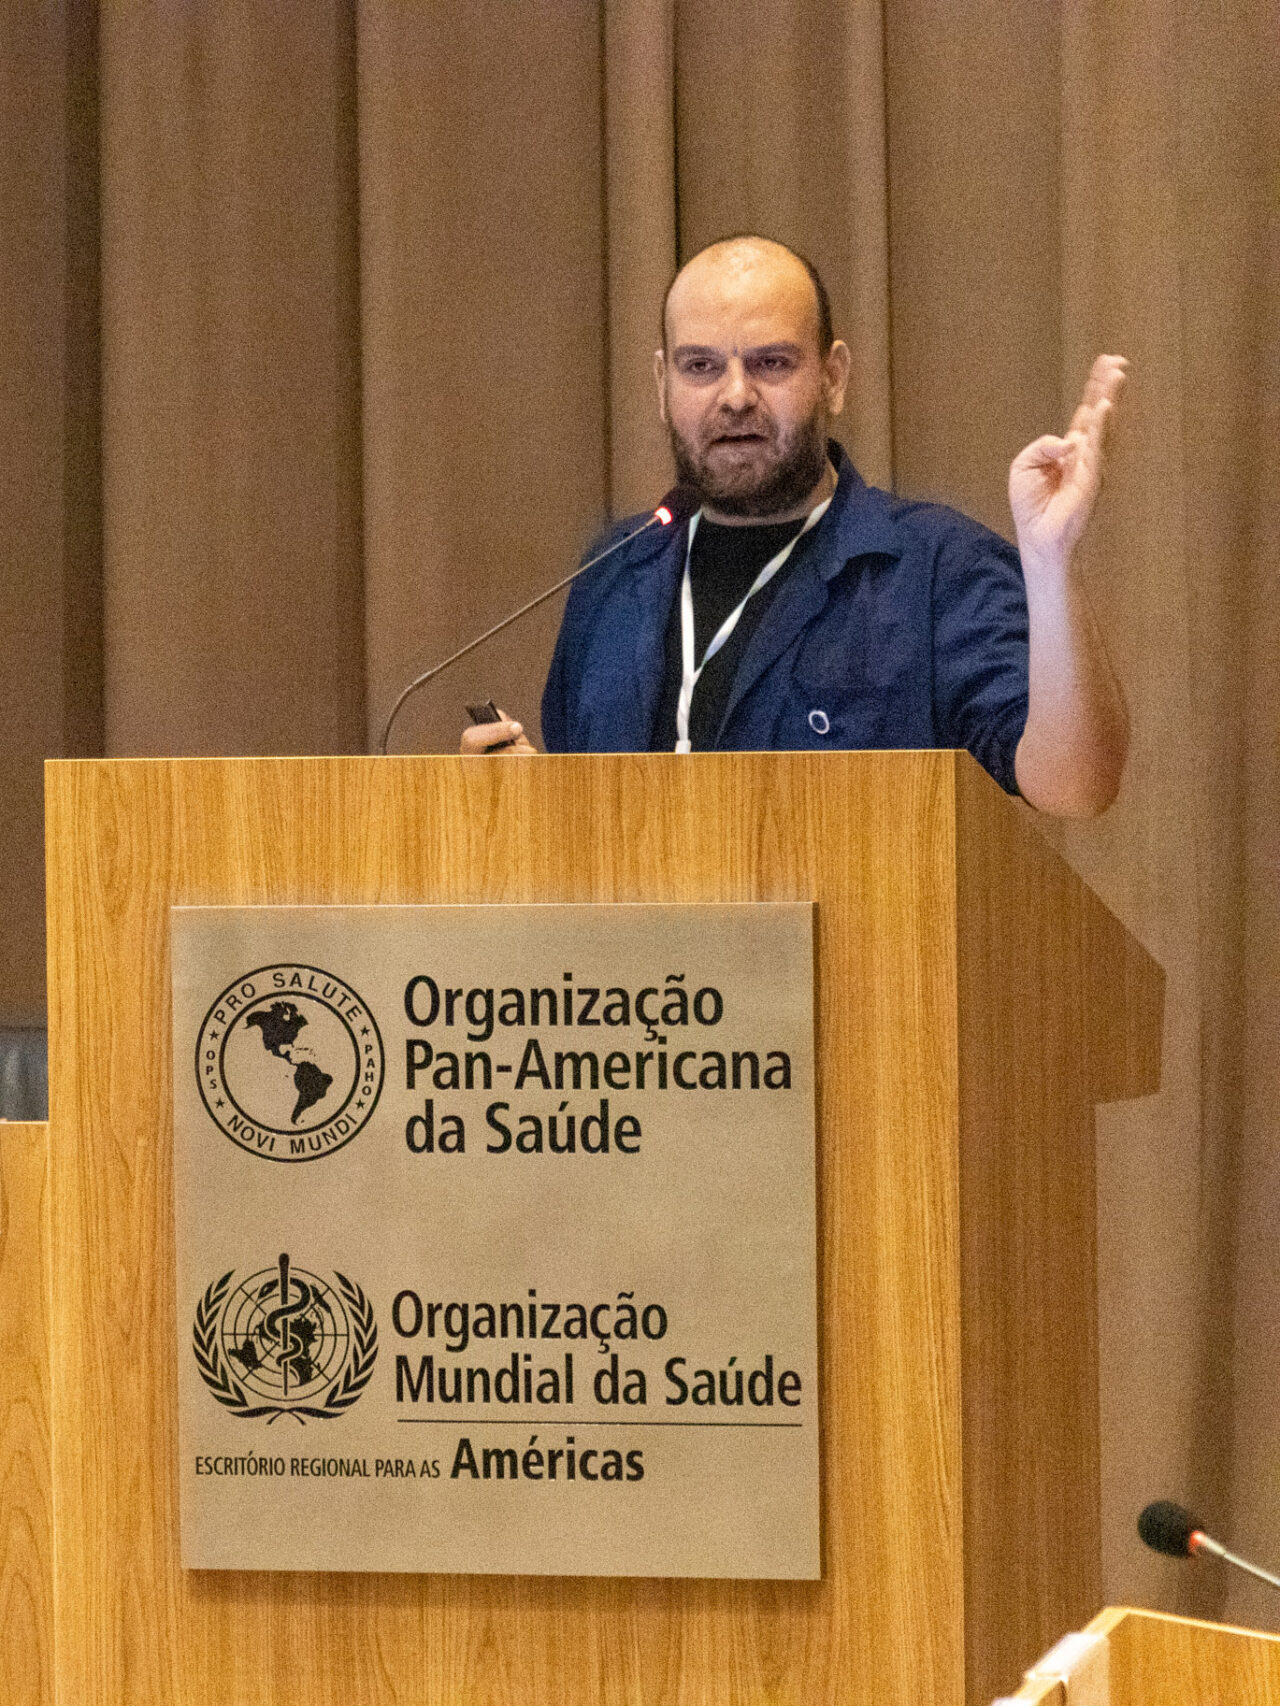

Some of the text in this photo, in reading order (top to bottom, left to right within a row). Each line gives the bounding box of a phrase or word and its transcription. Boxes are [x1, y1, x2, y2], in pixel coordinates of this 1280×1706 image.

[214, 972, 362, 1025] PRO SALUTE
[404, 972, 724, 1038] Organização
[206, 1050, 218, 1089] OPS
[361, 1044, 376, 1096] PAHO
[405, 1036, 792, 1090] Pan-Americana
[227, 1113, 358, 1155] NOVI MUNDI
[405, 1098, 642, 1154] da Saúde
[392, 1288, 668, 1351] Organização
[395, 1349, 802, 1407] Mundial da Saúde
[195, 1435, 645, 1482] ESCRITÓRIO REGIONAL PARA AS Américas
